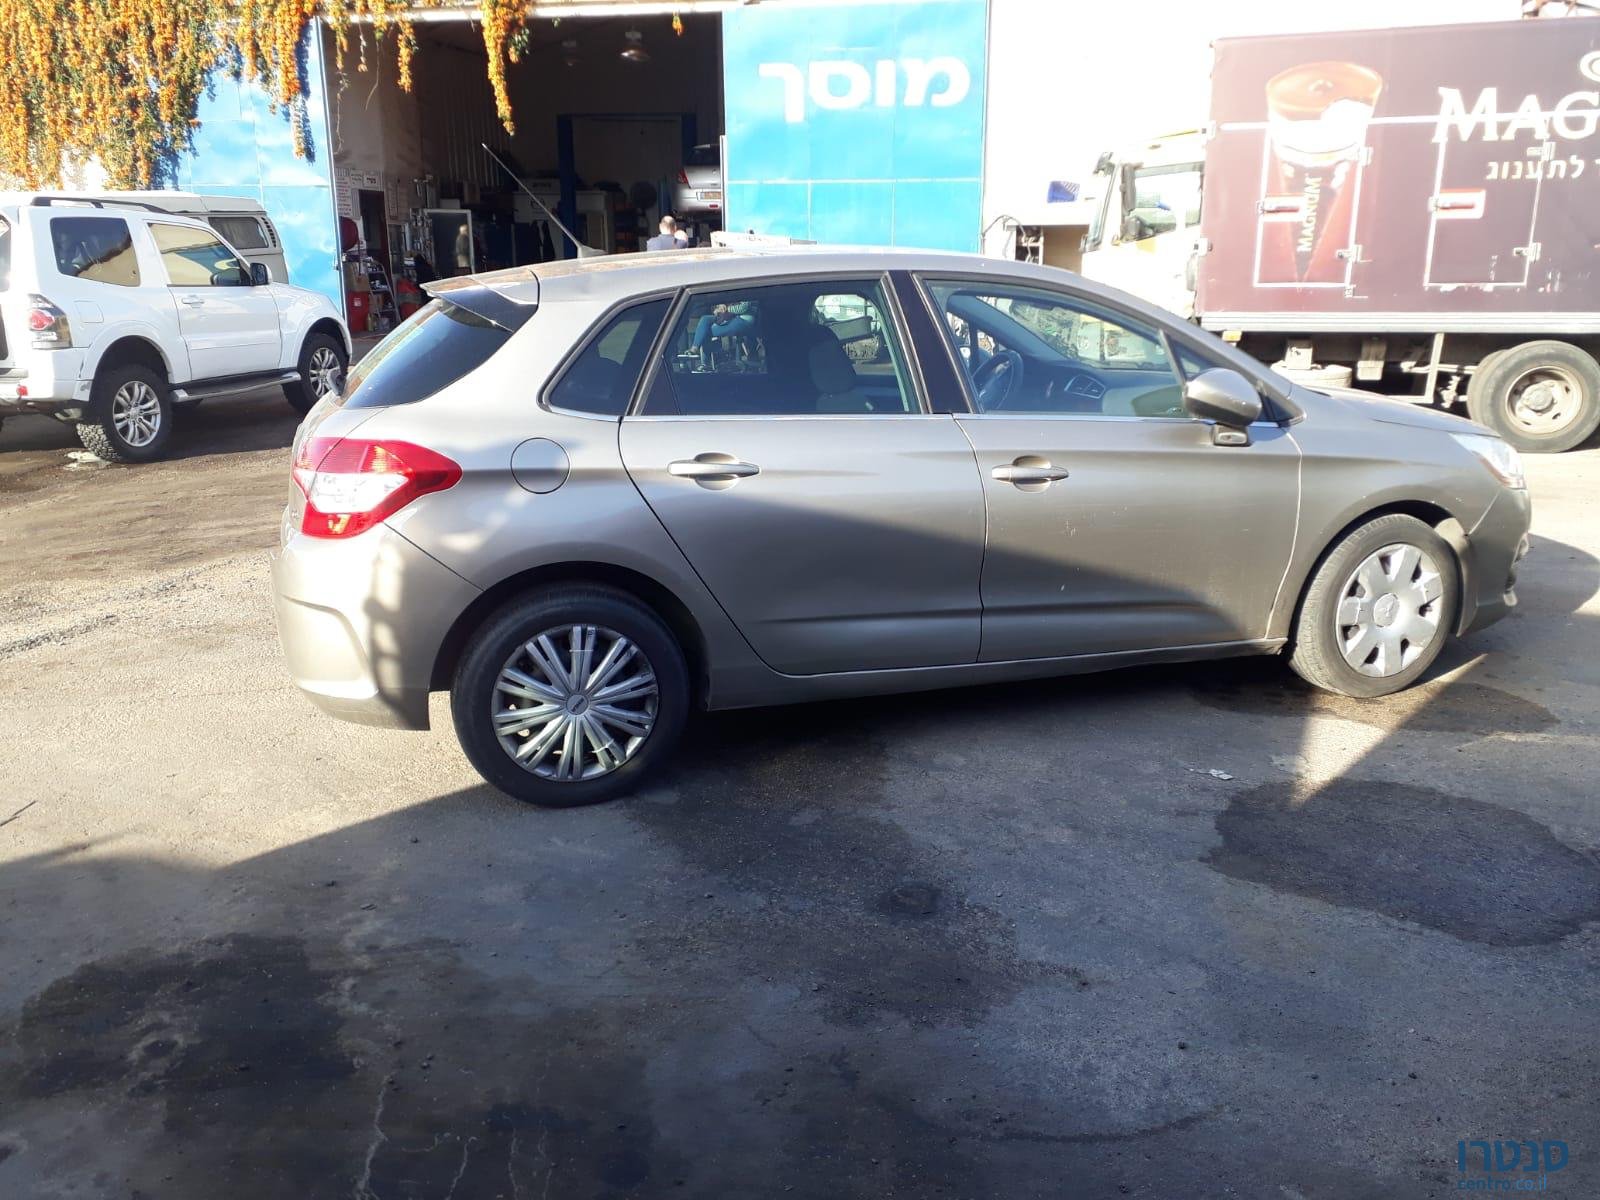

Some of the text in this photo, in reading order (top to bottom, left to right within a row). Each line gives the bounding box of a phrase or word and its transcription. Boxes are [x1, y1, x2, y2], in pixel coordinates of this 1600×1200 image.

[758, 56, 971, 123] מוסך
[1485, 155, 1585, 180] לתענוג
[1296, 176, 1322, 252] MAGNUM
